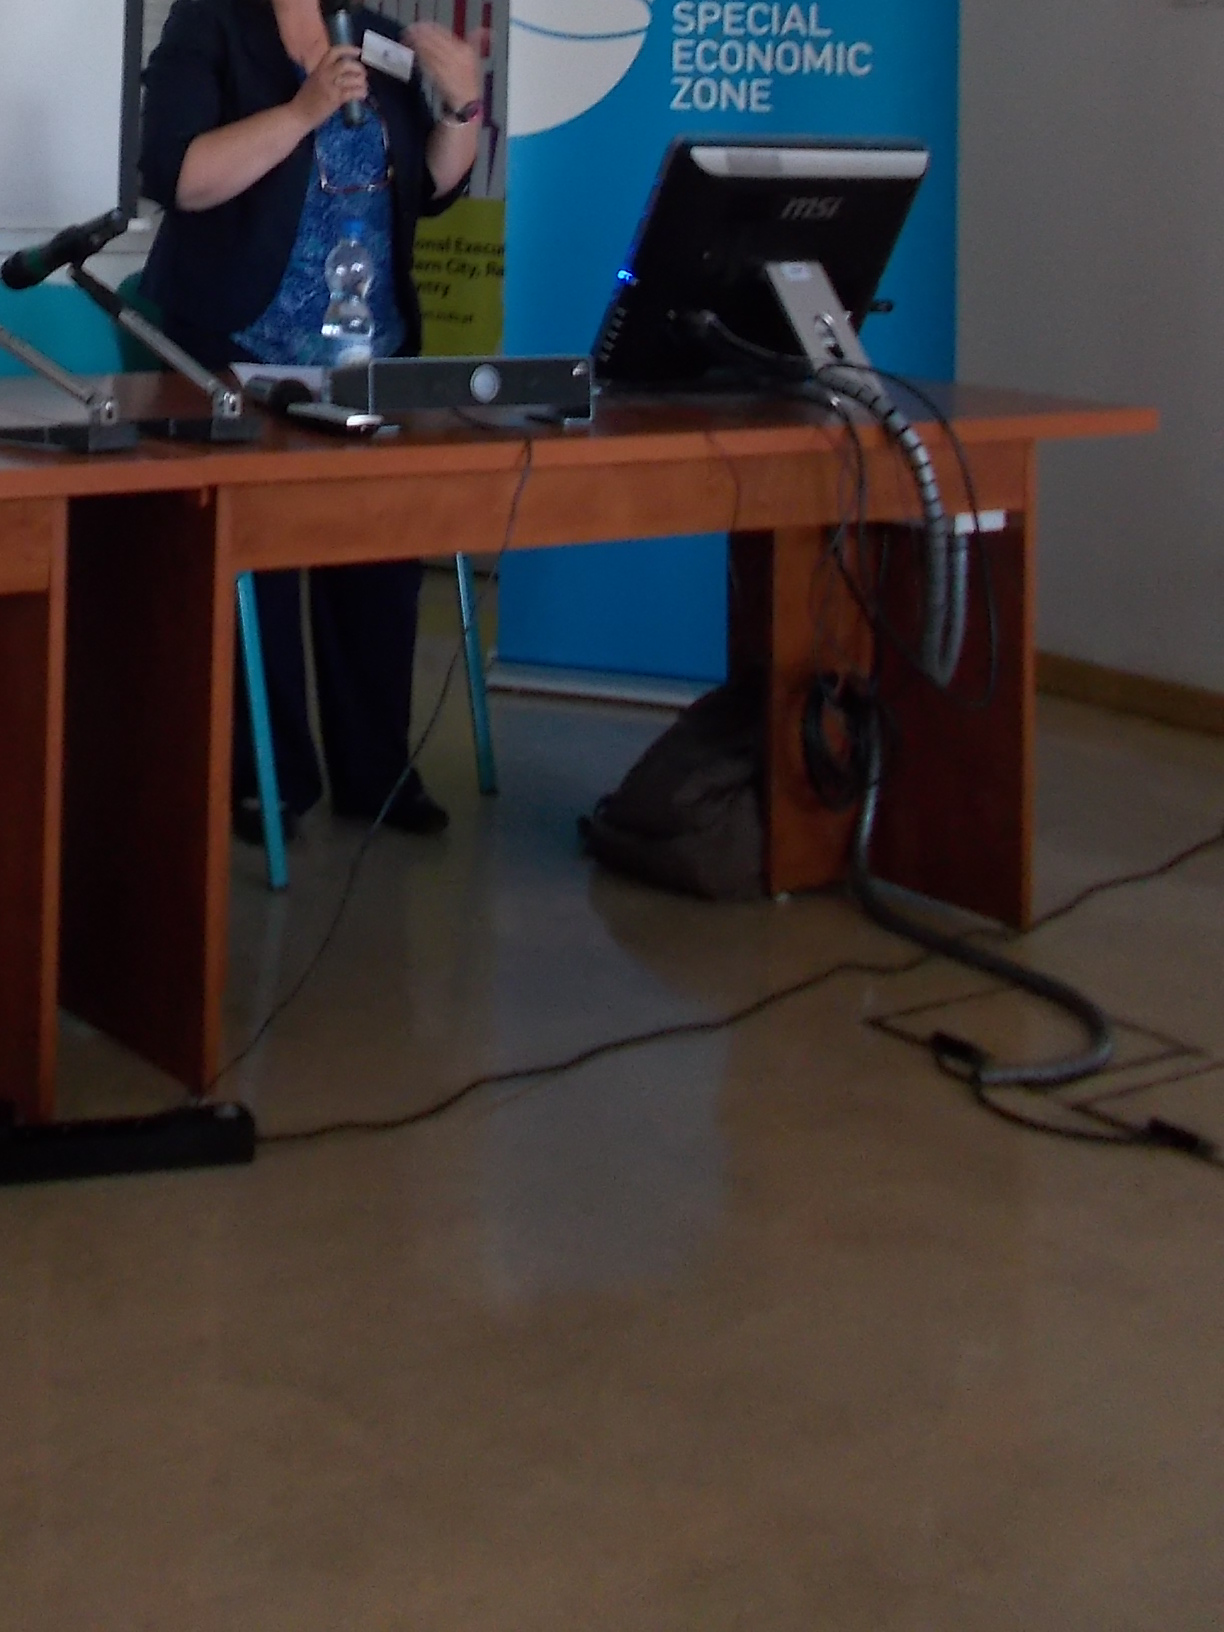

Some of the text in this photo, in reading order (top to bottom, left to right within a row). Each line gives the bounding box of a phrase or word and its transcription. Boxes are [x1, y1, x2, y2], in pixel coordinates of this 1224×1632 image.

[672, 1, 833, 38] SPECIAL
[672, 38, 873, 77] ECONOMIC
[670, 76, 774, 113] ZONE
[780, 197, 843, 220] msi
